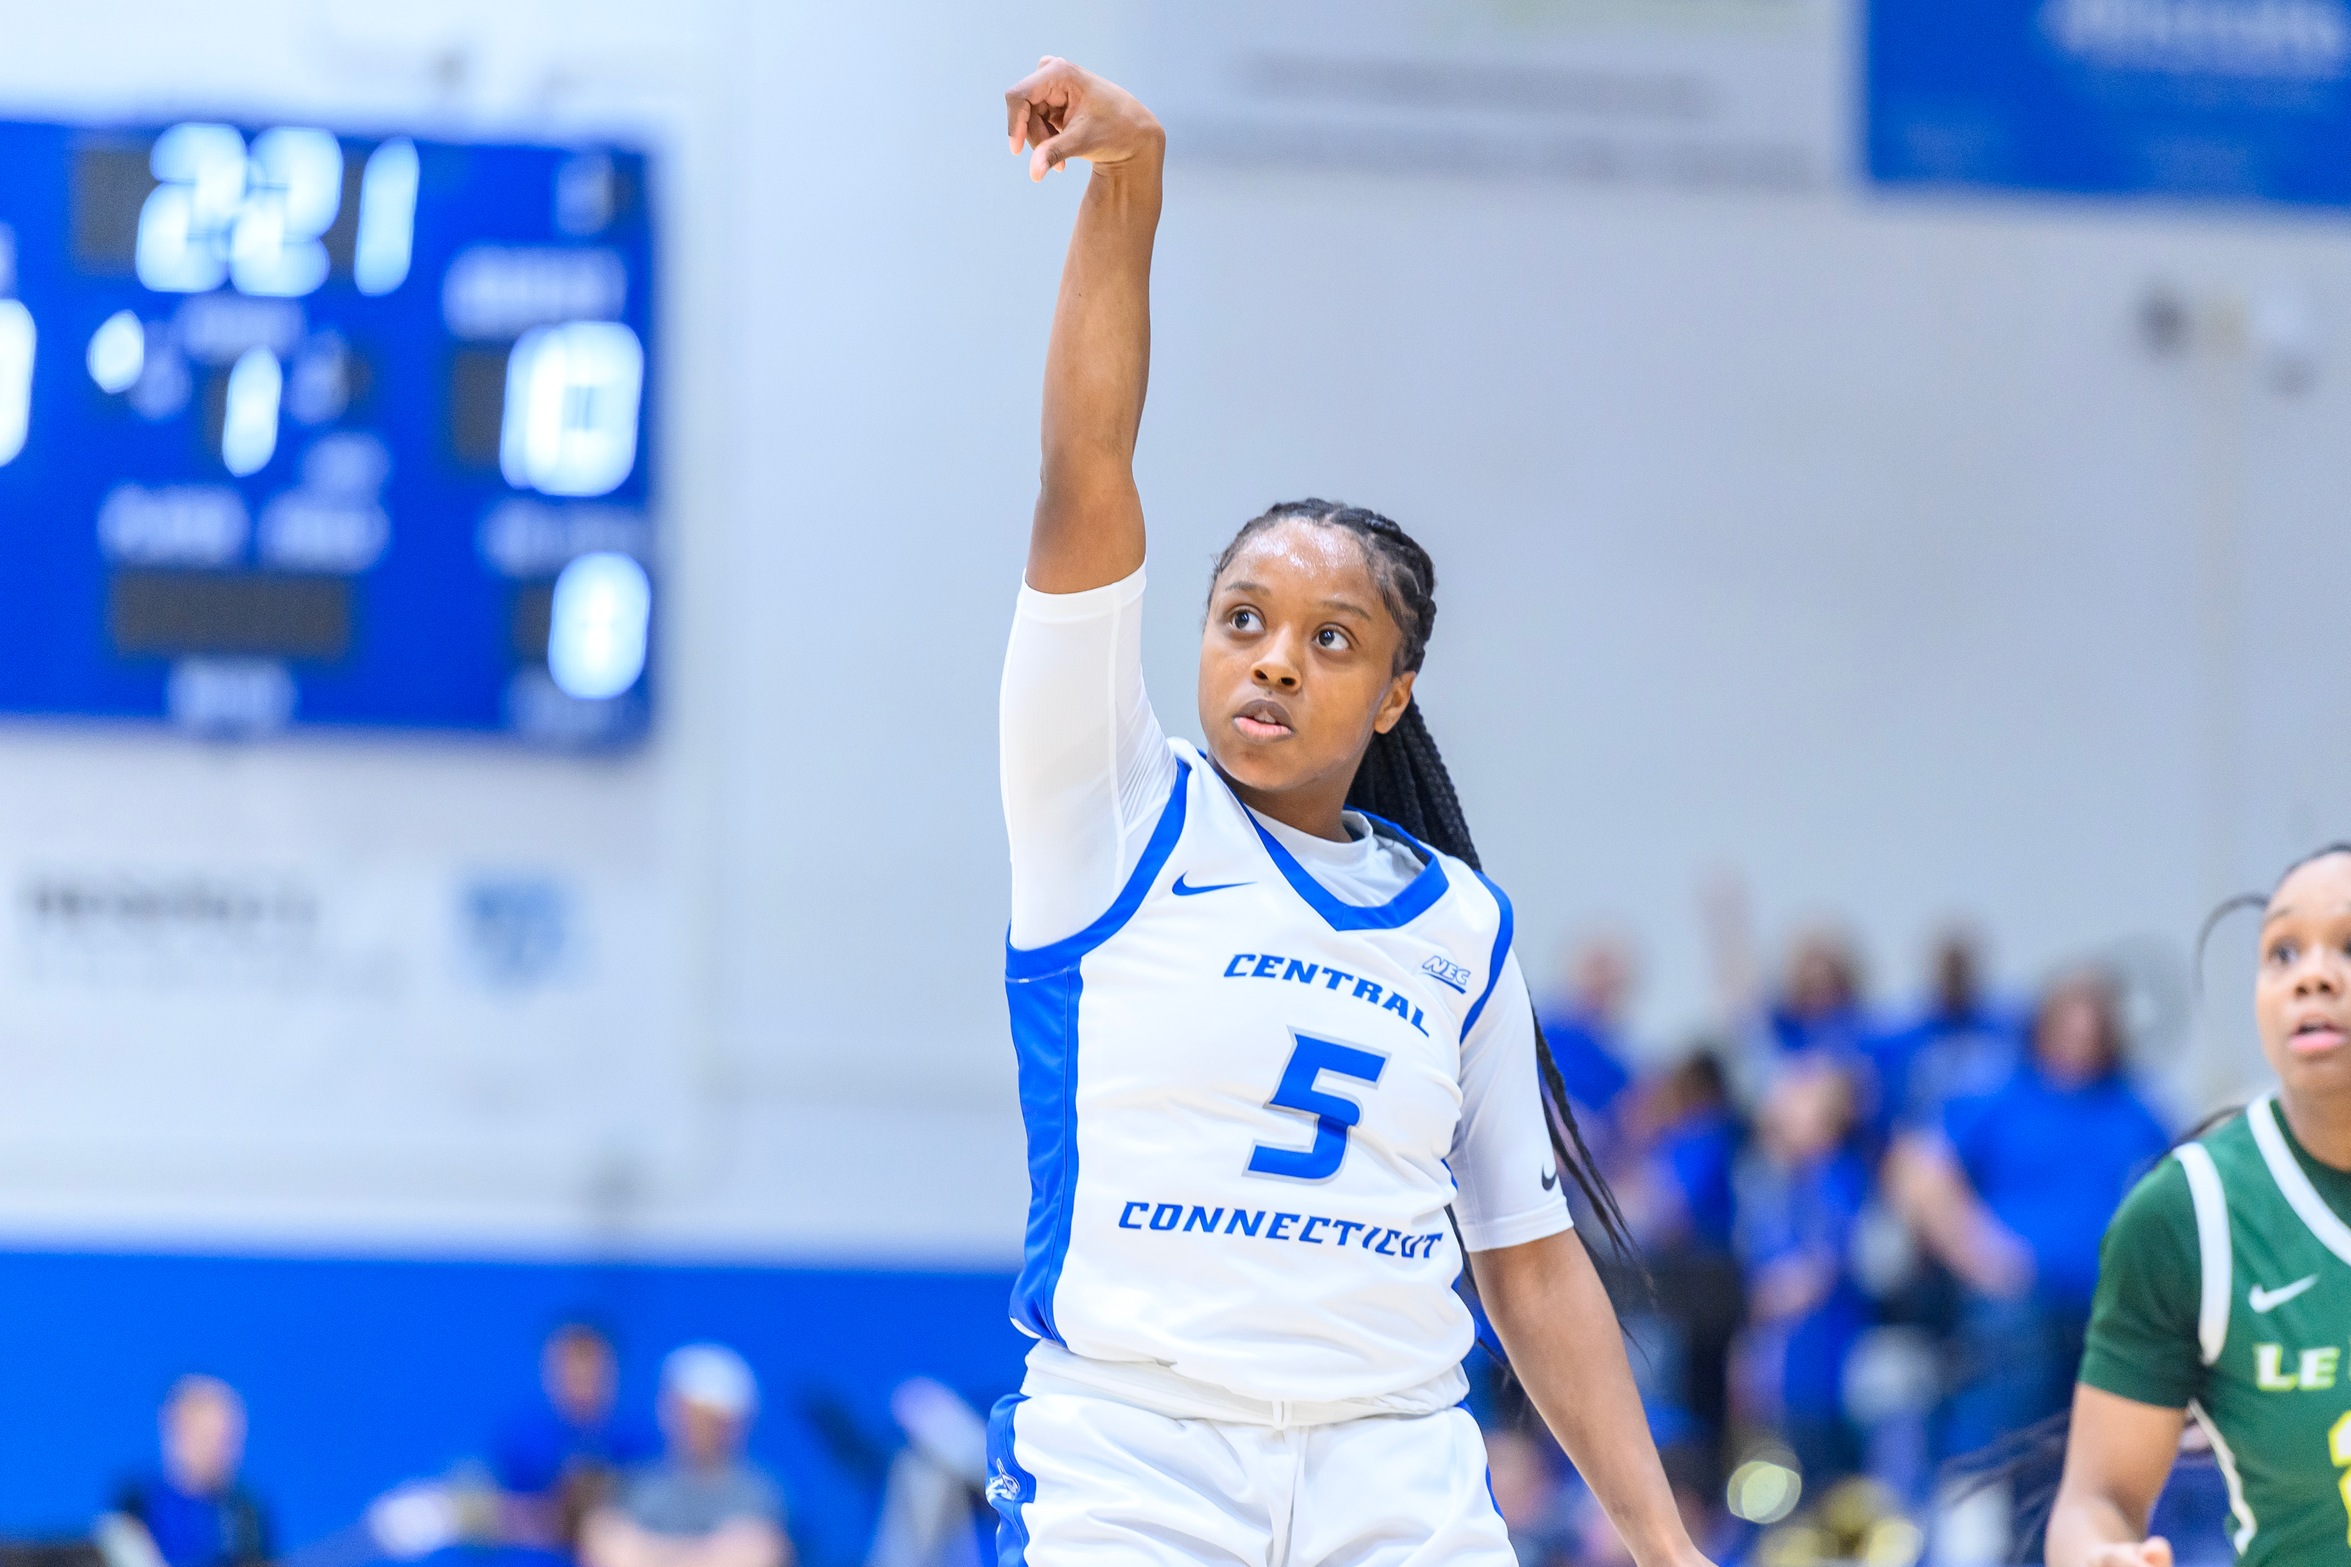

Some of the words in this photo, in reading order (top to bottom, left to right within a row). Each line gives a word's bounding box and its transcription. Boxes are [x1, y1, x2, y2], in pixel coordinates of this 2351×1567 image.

[1223, 953, 1430, 1038] CENTRAL
[1422, 955, 1471, 987] NEC
[1242, 1025, 1392, 1186] 5
[1118, 1201, 1443, 1259] CONNECTICUT
